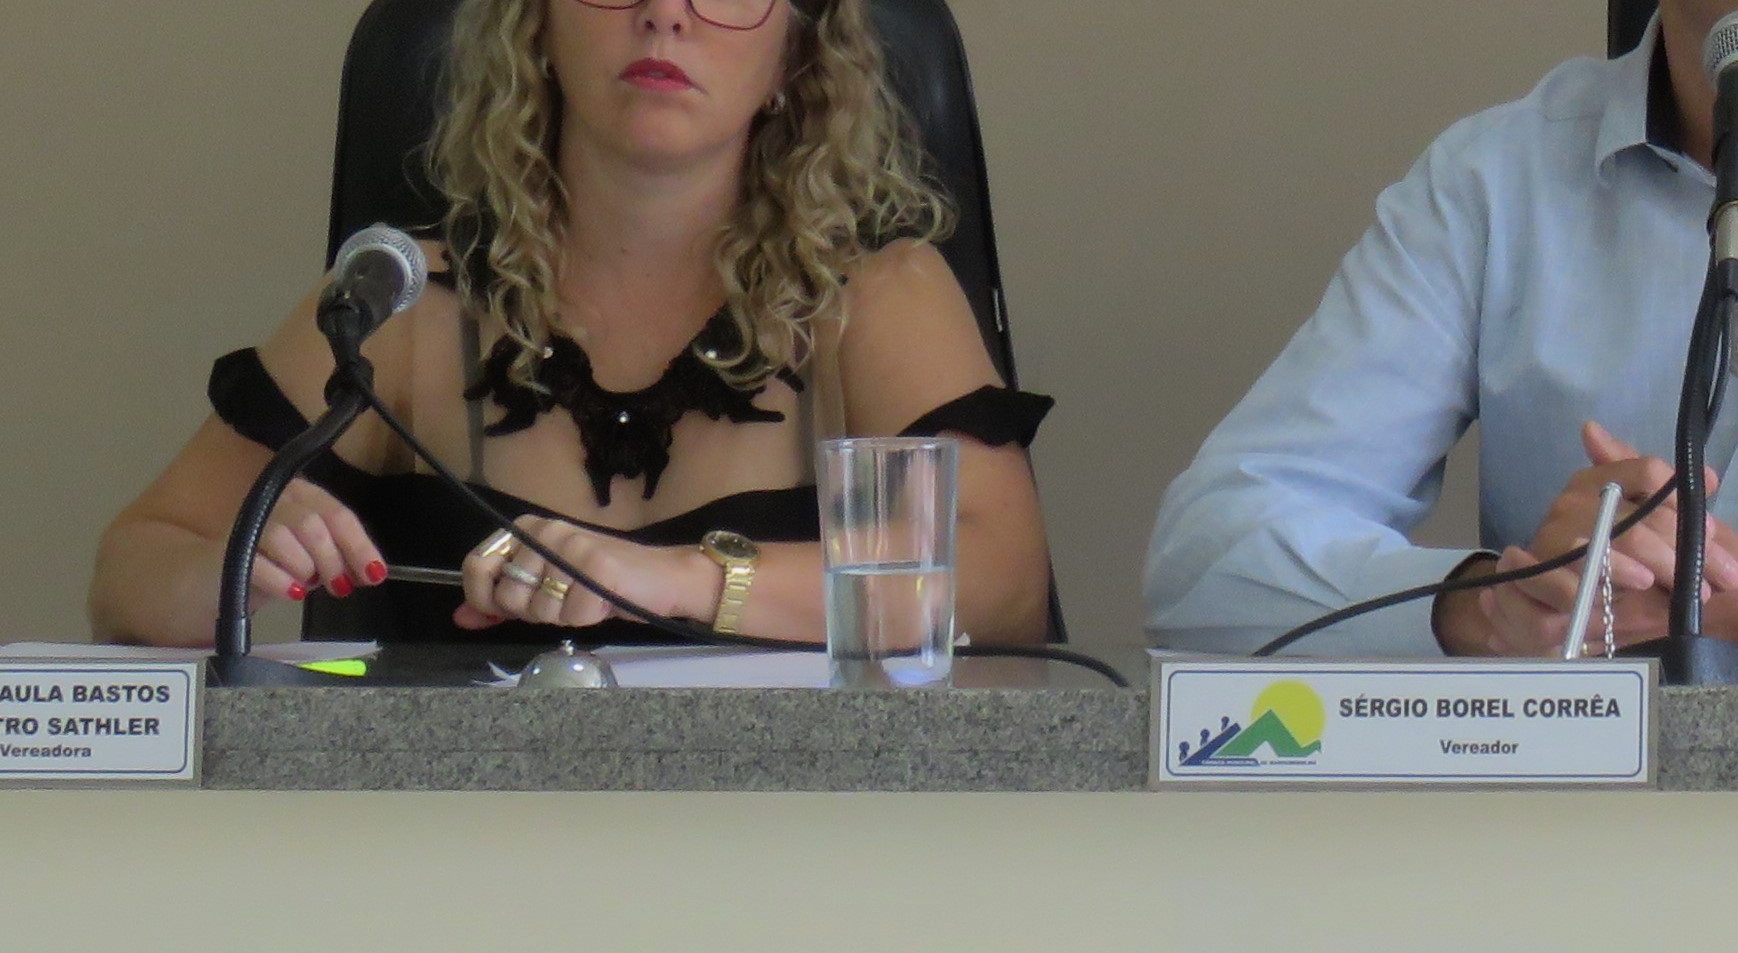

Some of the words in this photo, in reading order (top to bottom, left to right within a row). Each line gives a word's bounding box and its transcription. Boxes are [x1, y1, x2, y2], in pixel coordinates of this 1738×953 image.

[73, 685, 170, 703] BASTOS
[1339, 694, 1428, 717] SÉRGIO
[1436, 698, 1515, 717] BOREL
[1523, 695, 1621, 717] CORRÊA
[47, 718, 160, 736] SATHLER
[0, 743, 92, 758] Vereadora
[1440, 740, 1519, 754] Vereador
